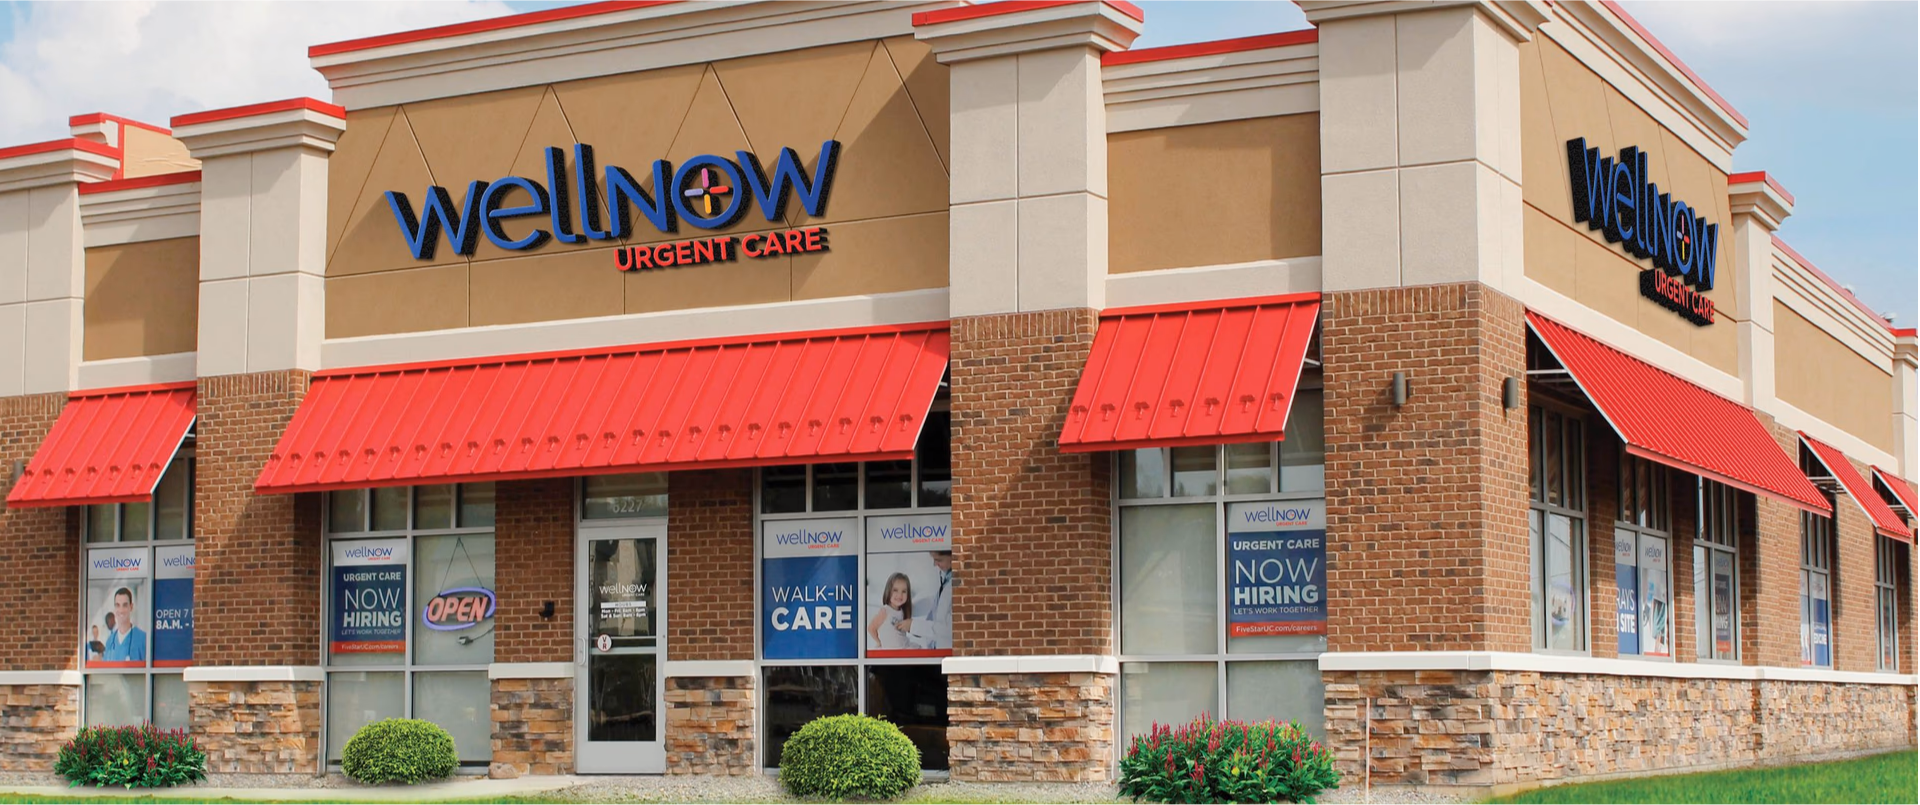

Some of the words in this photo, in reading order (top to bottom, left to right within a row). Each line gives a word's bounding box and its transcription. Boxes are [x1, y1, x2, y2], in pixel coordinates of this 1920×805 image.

[384, 139, 838, 260] wellNOW
[1580, 136, 1719, 290] wellNOW
[613, 236, 731, 272] URGENT
[741, 227, 822, 258] CARE
[1654, 267, 1691, 310] URGENT
[1691, 290, 1715, 325] CARE
[1244, 506, 1311, 523] wellNOW
[776, 529, 843, 545] wellNOW
[880, 523, 947, 539] wellNOW
[345, 546, 393, 558] wellNOW
[1233, 540, 1284, 551] URGENT
[1286, 538, 1320, 549] CARE
[93, 557, 142, 569] wellNOW
[1235, 557, 1319, 584] NOW
[343, 572, 377, 582] URGENT
[378, 571, 402, 581] CARE
[598, 582, 648, 595] wellNOW
[771, 584, 853, 603] WALK-IN
[1234, 584, 1319, 606] HIRING
[345, 587, 400, 610] NOW
[156, 609, 181, 619] OPEN
[183, 608, 189, 618] 7
[427, 596, 488, 622] OPEN
[771, 605, 852, 631] CARE
[155, 619, 183, 630] 8A.M.
[343, 610, 402, 628] HIRING
[1620, 613, 1635, 633] SITE
[1236, 624, 1317, 633] FiveStarUC.com/careers
